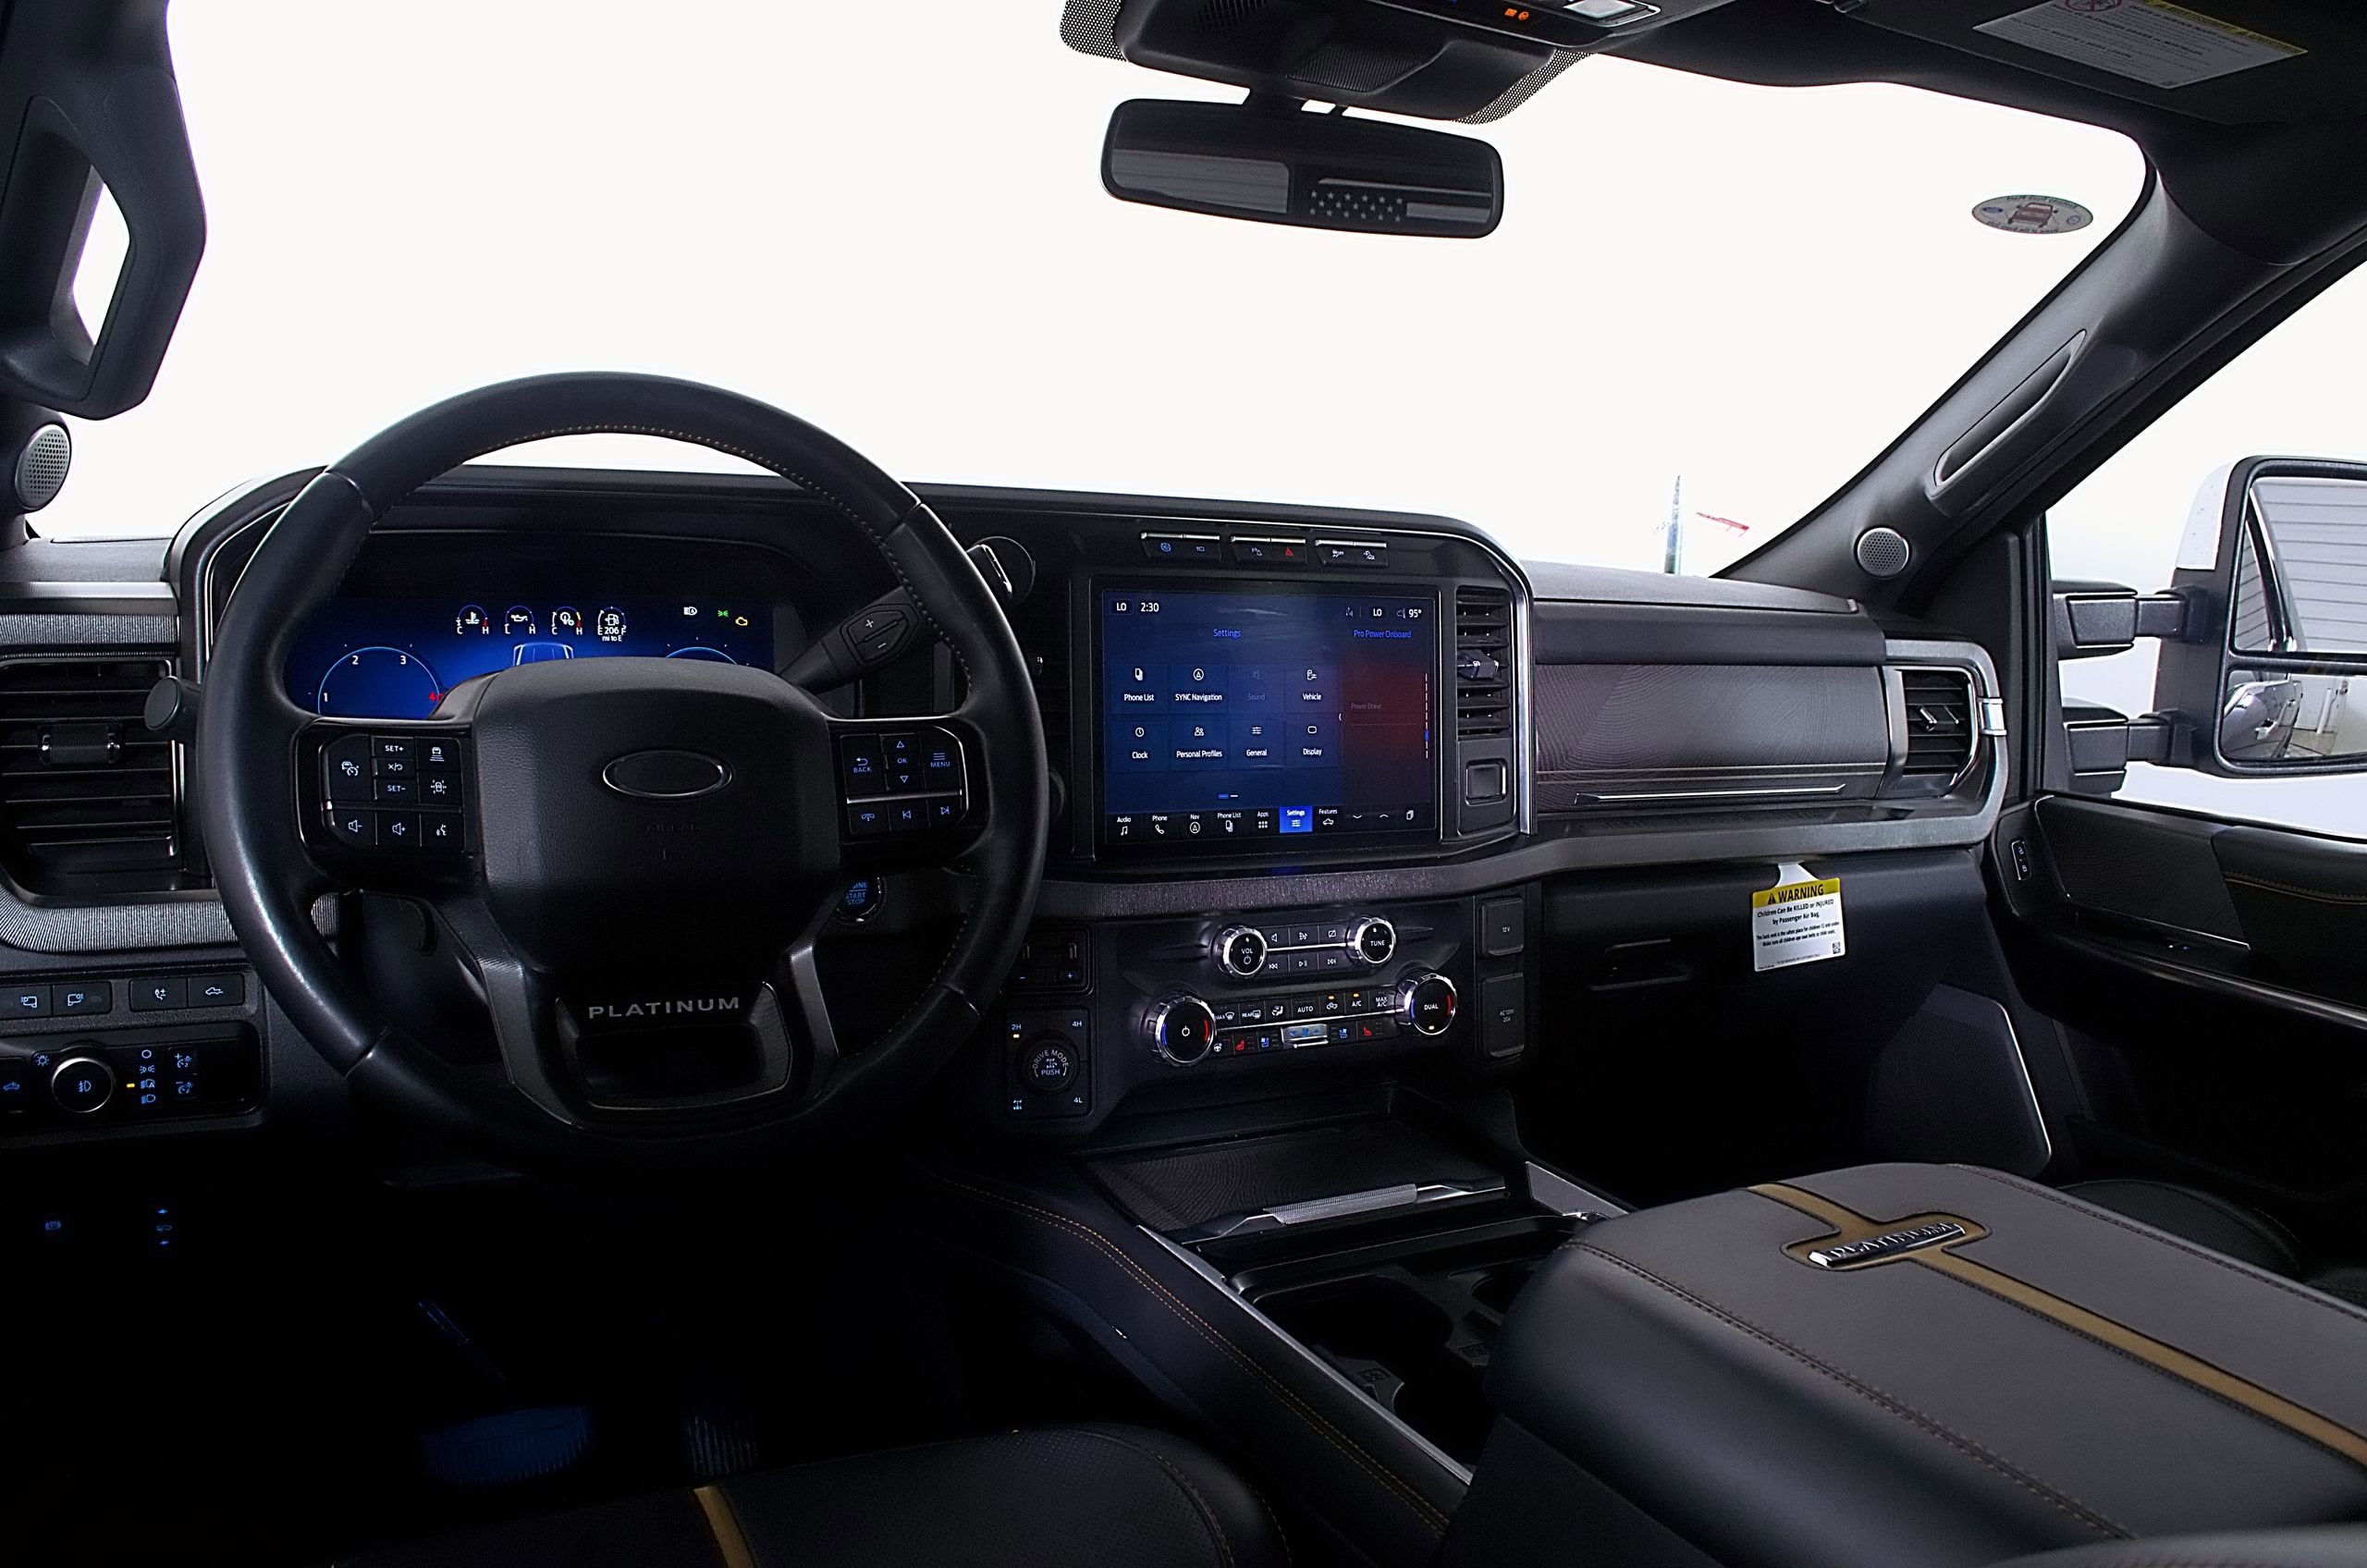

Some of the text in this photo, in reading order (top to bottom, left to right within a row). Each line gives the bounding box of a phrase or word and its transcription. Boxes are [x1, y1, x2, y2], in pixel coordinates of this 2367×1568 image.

[1116, 602, 1127, 611] LO
[1140, 602, 1159, 612] 2:30
[1373, 608, 1382, 617] LO
[604, 627, 619, 635] 206
[1213, 629, 1242, 639] Settings
[1354, 630, 1412, 639] Pro Power Onboard
[352, 655, 359, 665] 2
[400, 655, 407, 665] 3
[324, 692, 328, 703] 1
[1123, 693, 1155, 702] Phone List
[1191, 693, 1222, 703] Navigation
[1302, 692, 1322, 701] Vehicle
[1132, 751, 1147, 759] Clock
[1303, 748, 1322, 756] Display
[930, 760, 950, 768] MENU
[845, 891, 866, 900] START
[1777, 884, 1823, 902] WARNING
[1757, 909, 1776, 917] Children
[1816, 899, 1834, 907] INJURED
[1779, 915, 1802, 924] Passenger
[588, 997, 739, 1019] PLATINUM
[1032, 1049, 1069, 1069] DRIVE MODE
